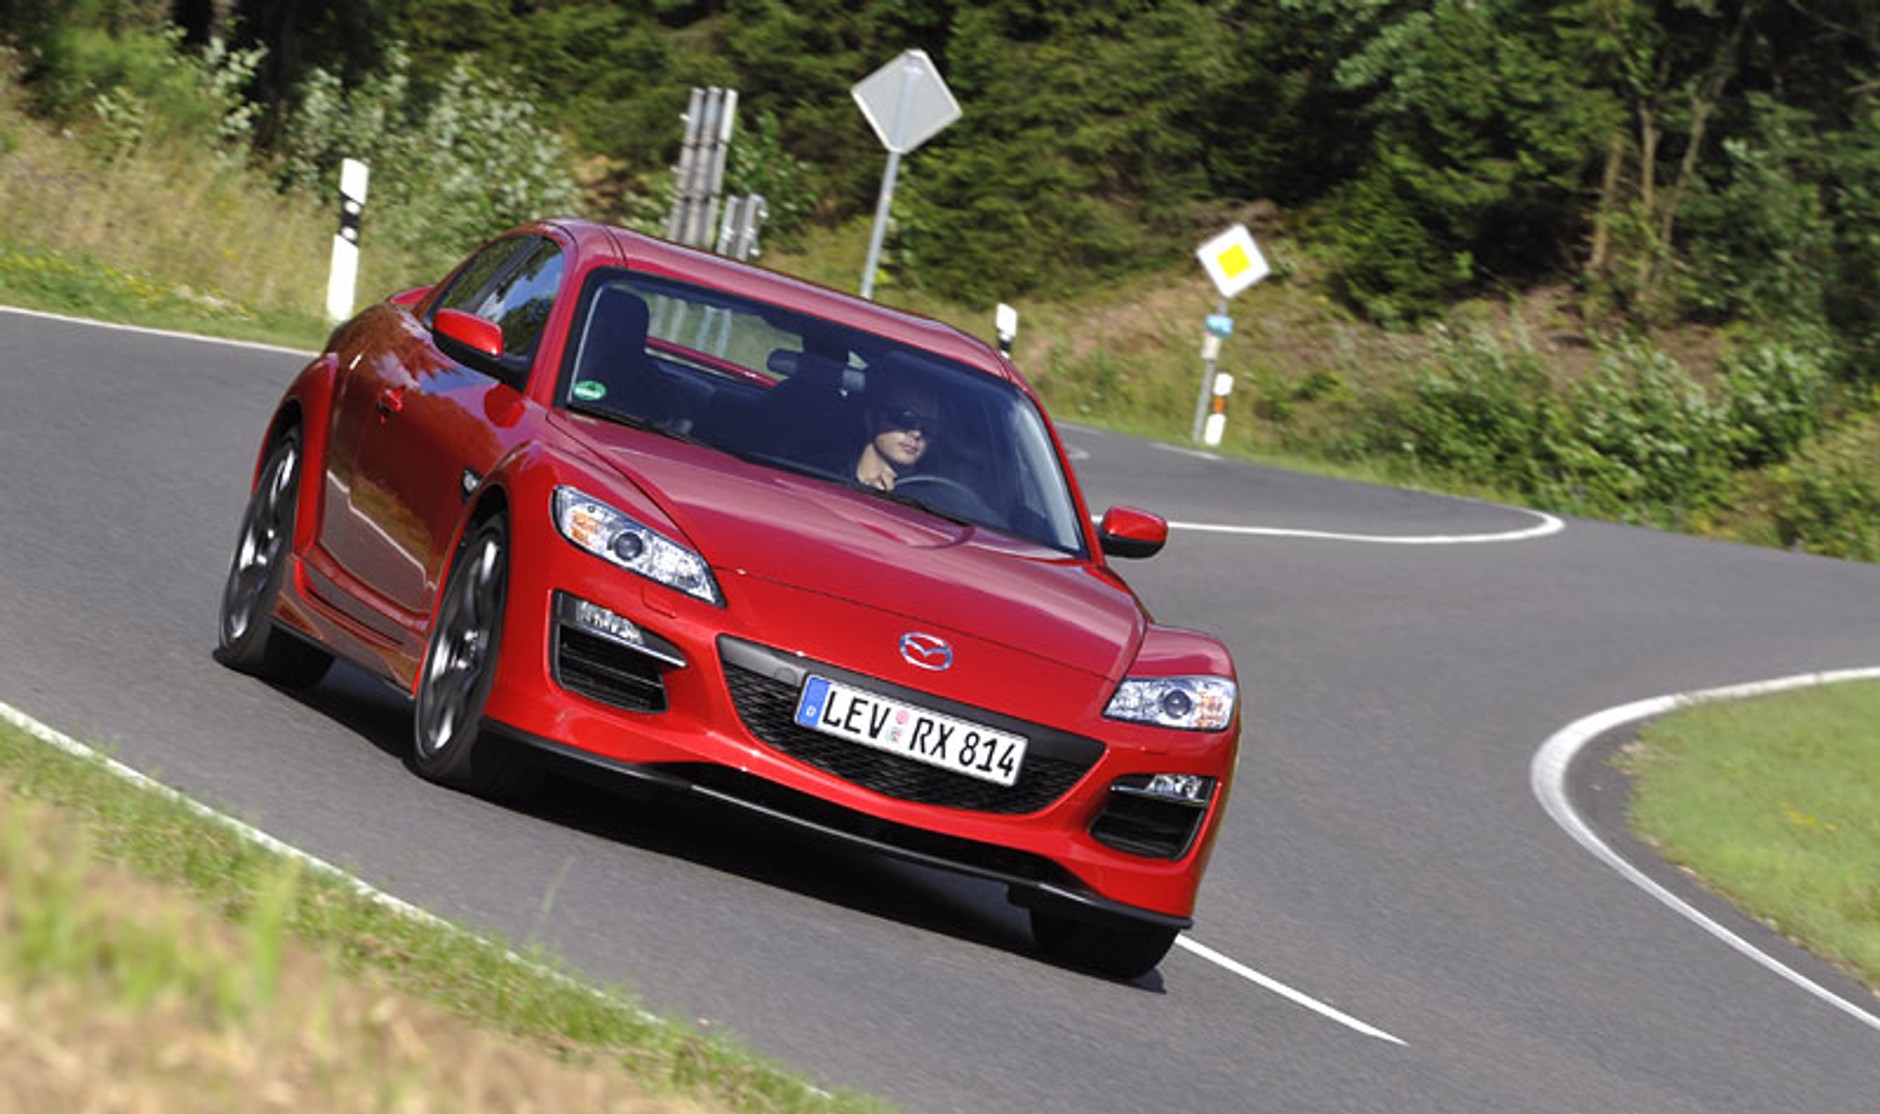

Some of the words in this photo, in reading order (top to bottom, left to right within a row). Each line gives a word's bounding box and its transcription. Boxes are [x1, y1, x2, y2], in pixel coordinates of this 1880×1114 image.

[822, 691, 891, 739] LEV
[909, 717, 955, 760] RX
[958, 731, 1016, 777] 814
